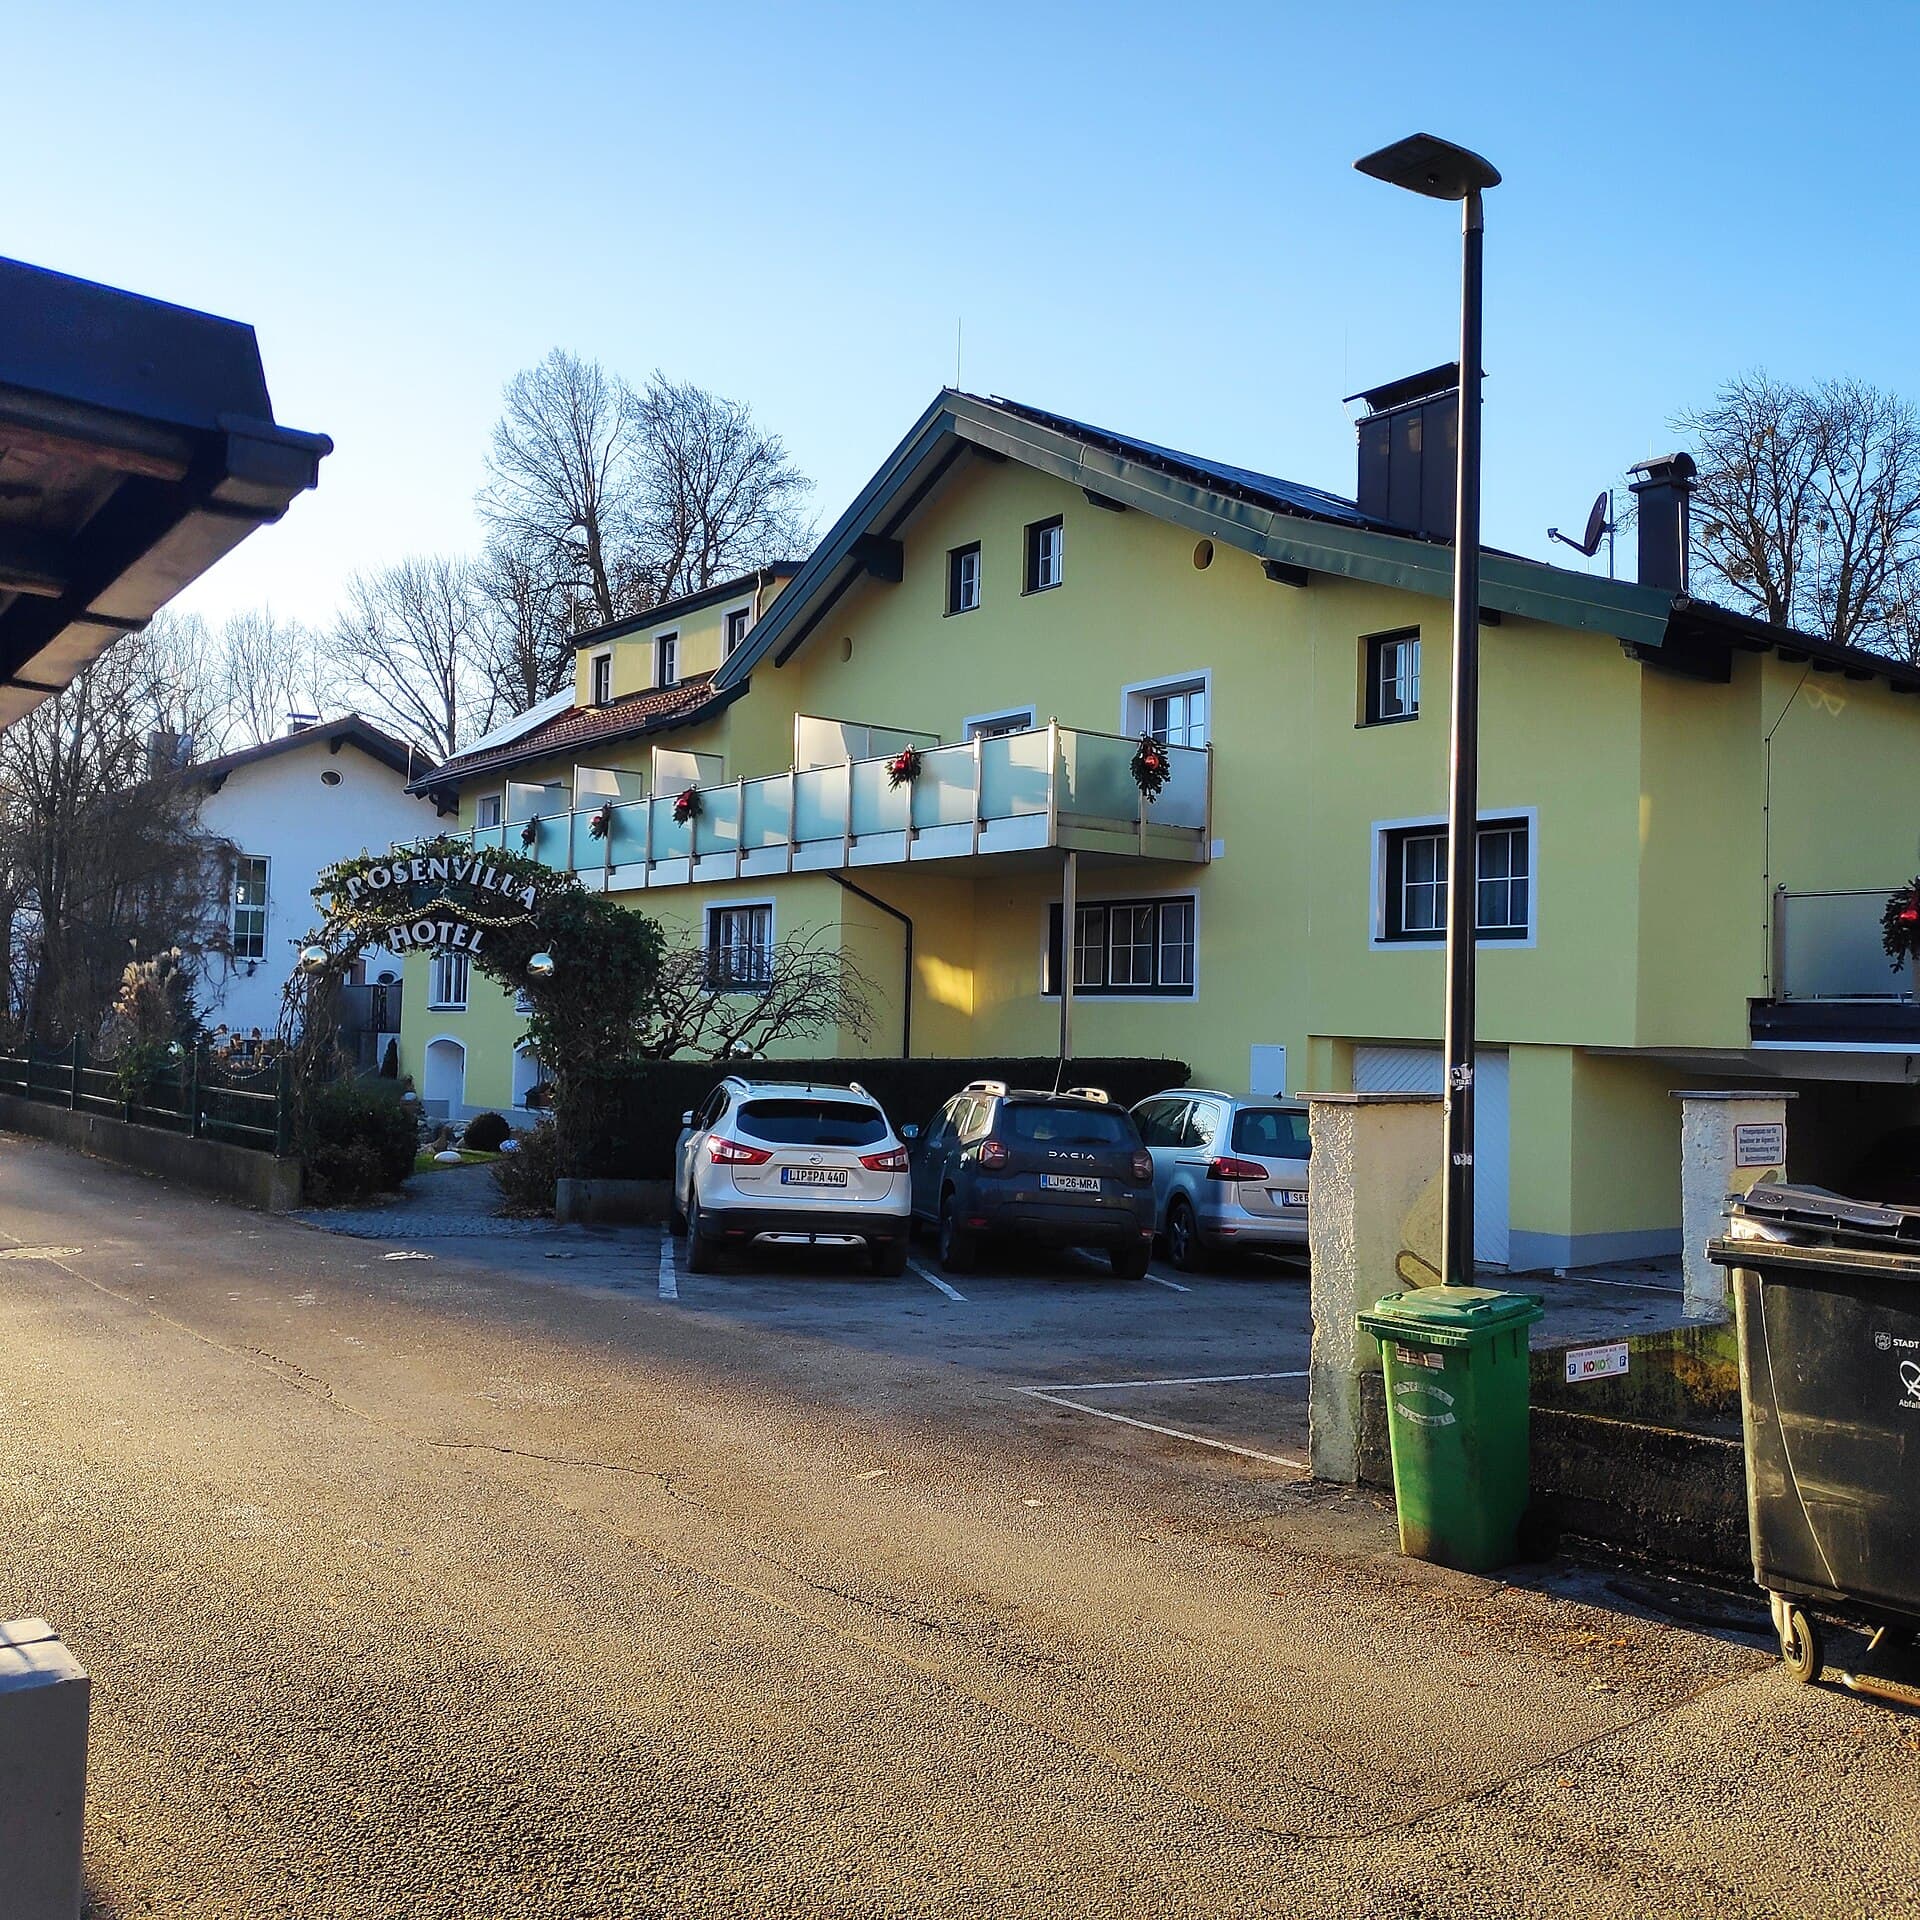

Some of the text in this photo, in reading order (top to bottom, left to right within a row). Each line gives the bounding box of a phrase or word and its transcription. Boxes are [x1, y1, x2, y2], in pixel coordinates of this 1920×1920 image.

[345, 857, 538, 911] ROSENVILLA
[386, 921, 485, 954] HOTEL
[1048, 1151, 1095, 1160] DACIA
[827, 1172, 845, 1183] 440
[1893, 1339, 1919, 1349] STADT
